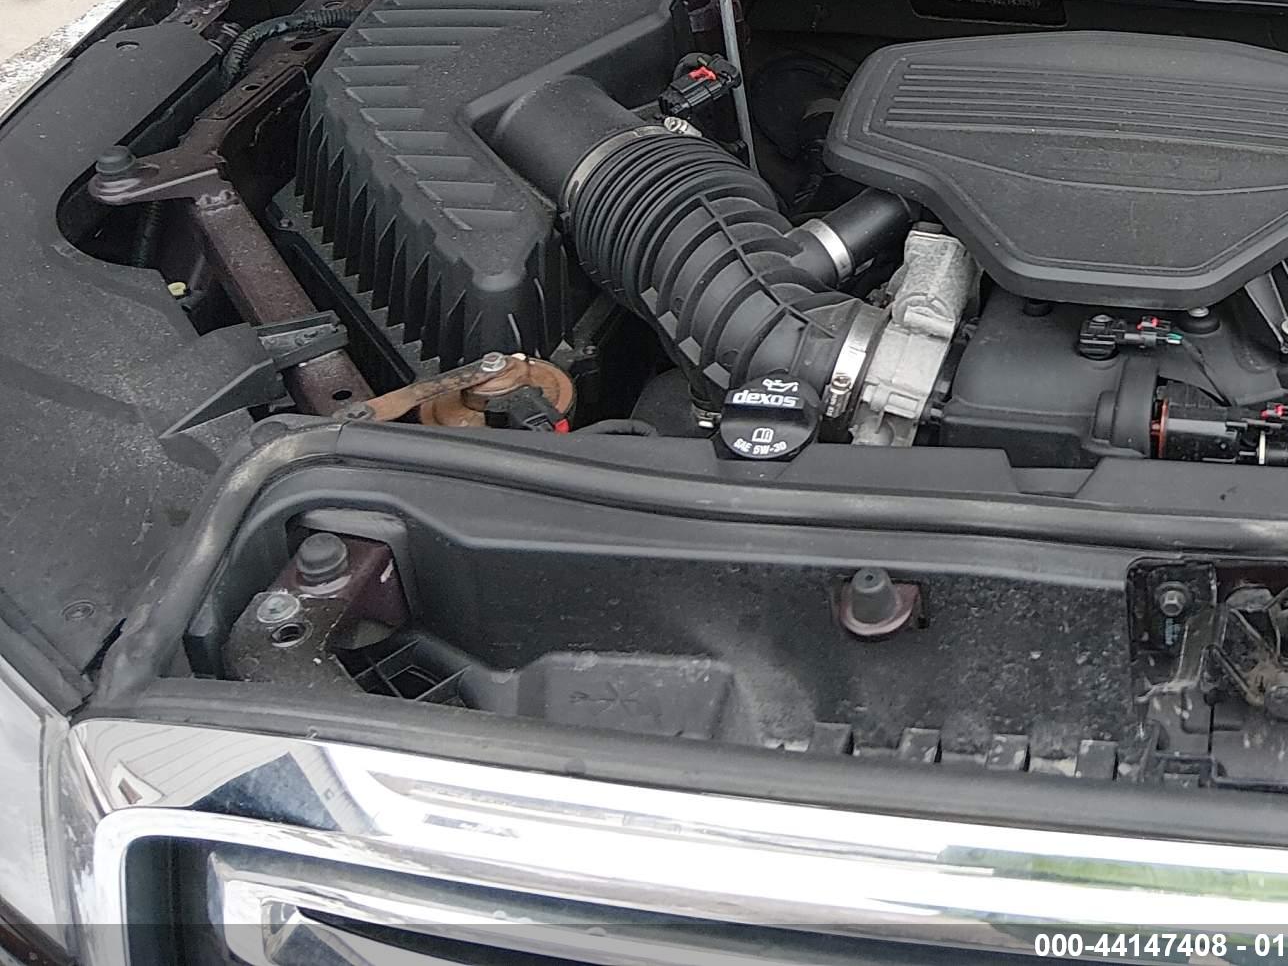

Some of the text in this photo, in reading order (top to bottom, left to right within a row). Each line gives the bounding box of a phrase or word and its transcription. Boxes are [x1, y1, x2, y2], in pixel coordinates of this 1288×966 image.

[732, 389, 800, 407] dexos
[733, 438, 787, 455] SAE 5W-30
